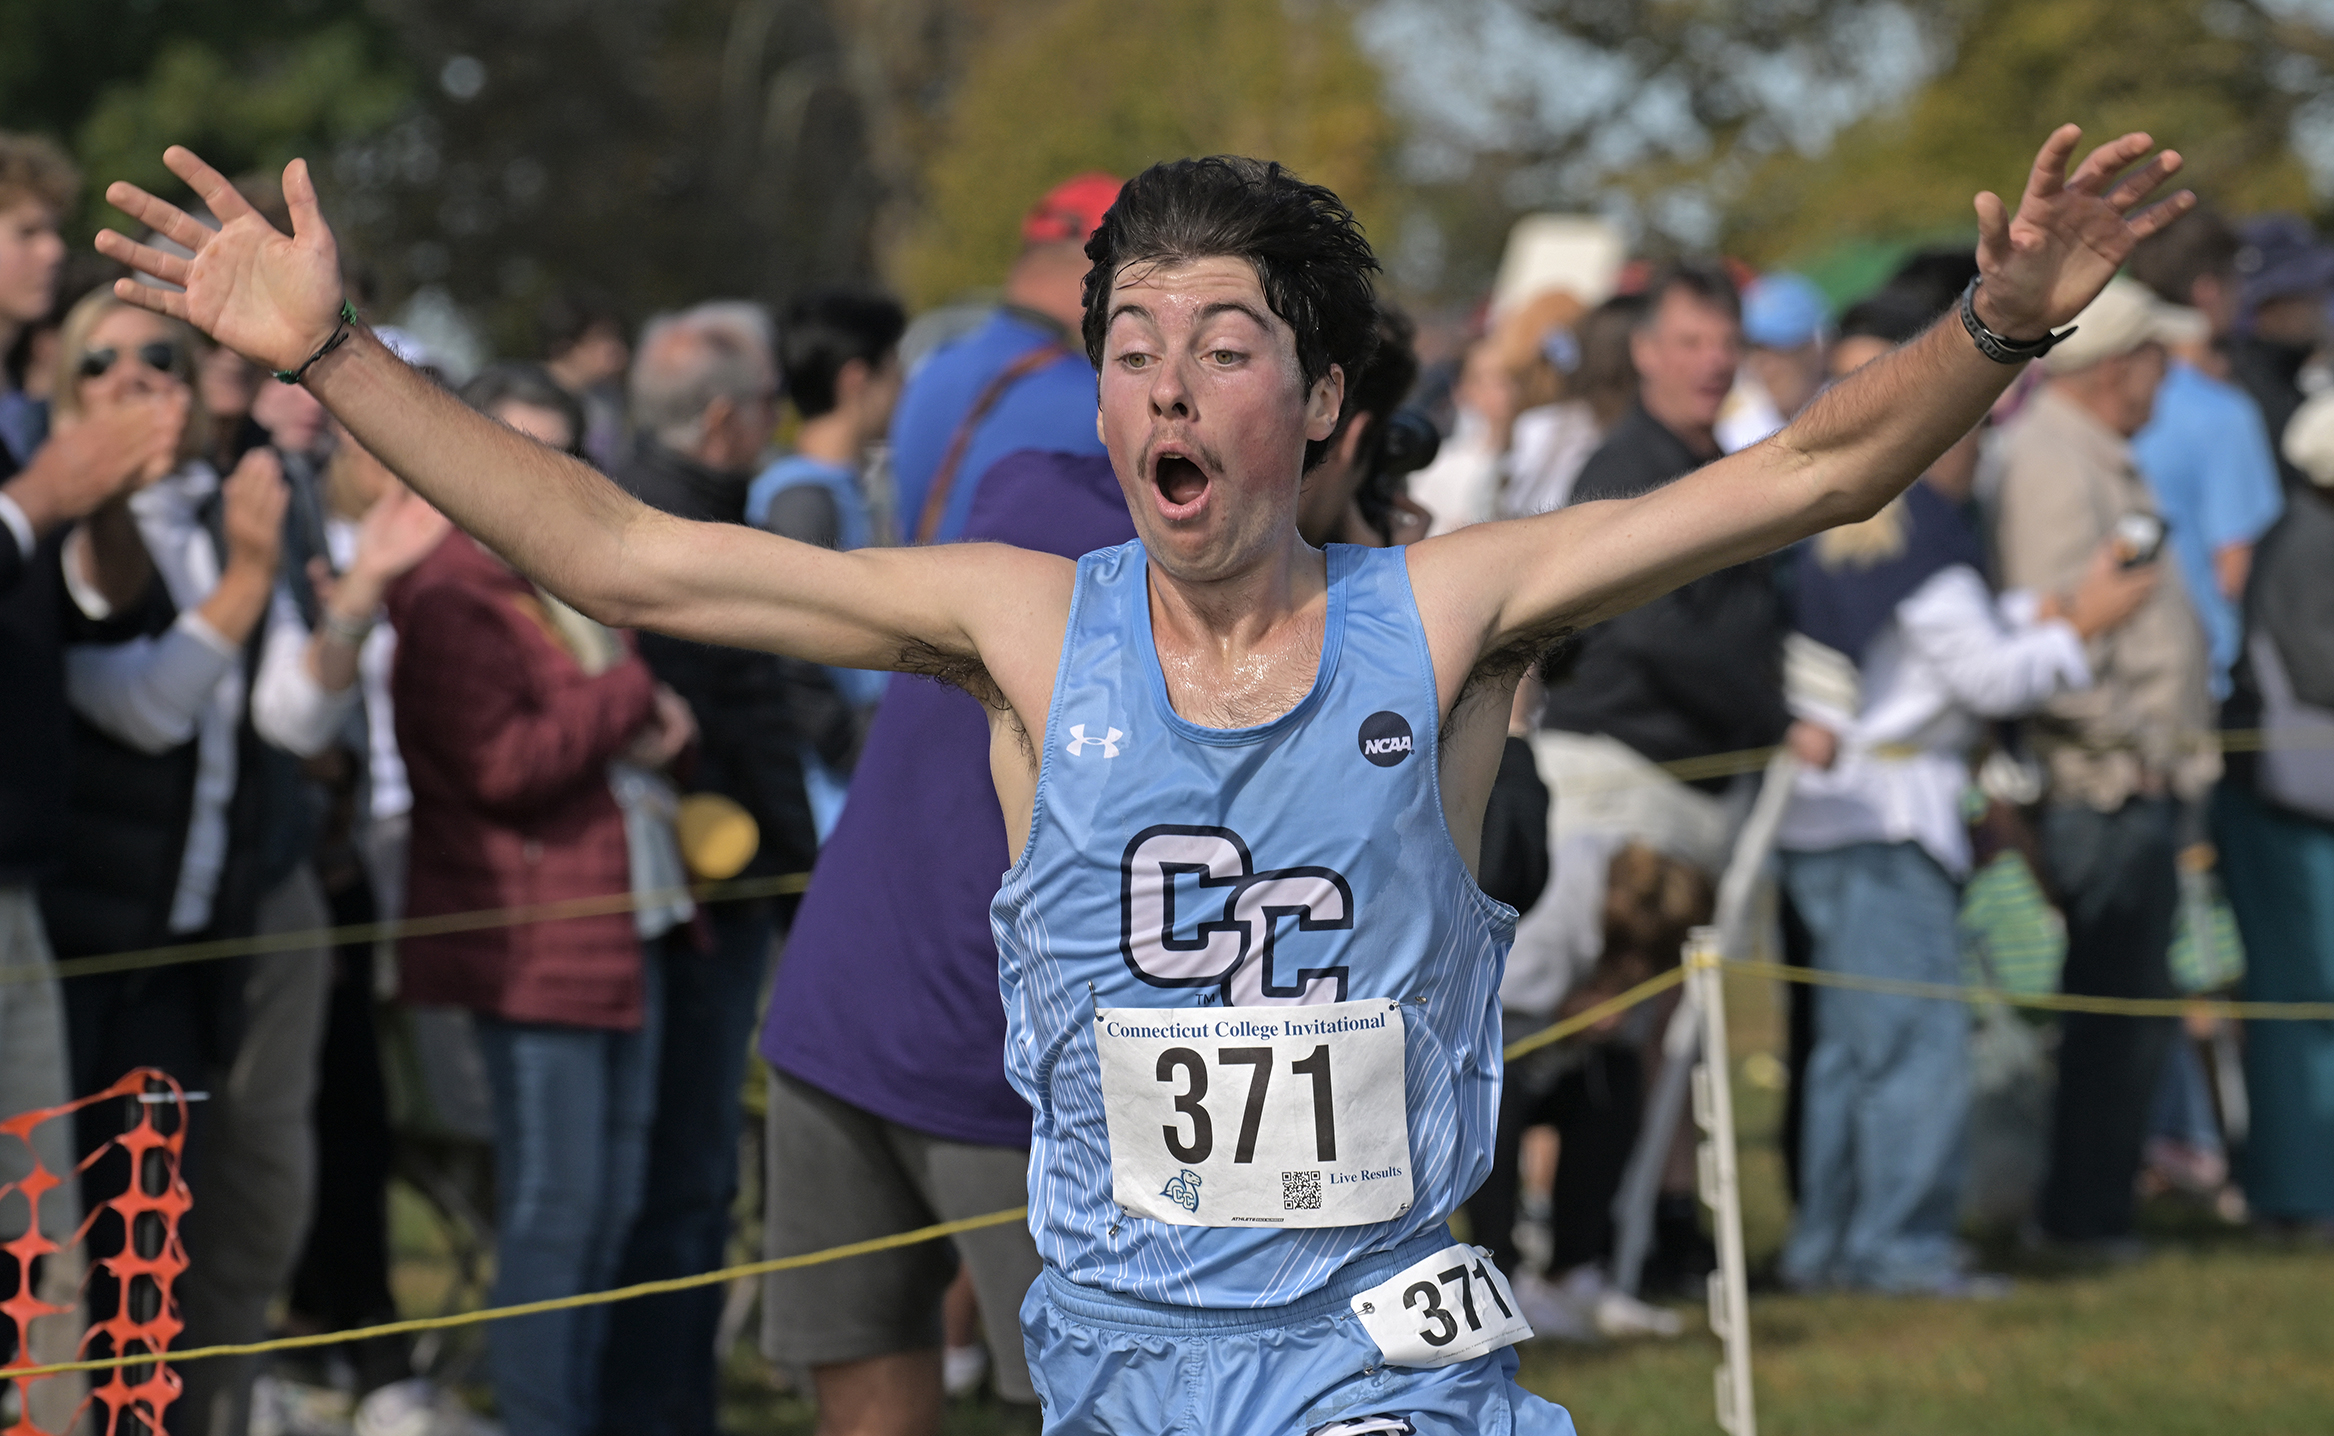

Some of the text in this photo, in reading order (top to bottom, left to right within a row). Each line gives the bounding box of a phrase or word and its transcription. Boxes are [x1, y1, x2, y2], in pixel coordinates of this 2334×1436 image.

[1365, 736, 1411, 755] NCAA
[1120, 824, 1354, 1007] CC
[1107, 1012, 1385, 1040] Connecticut College Invitational
[1156, 1044, 1337, 1164] 371
[1330, 1166, 1402, 1184] Live Results
[1171, 1185, 1195, 1210] CC
[1402, 1257, 1514, 1347] 371
